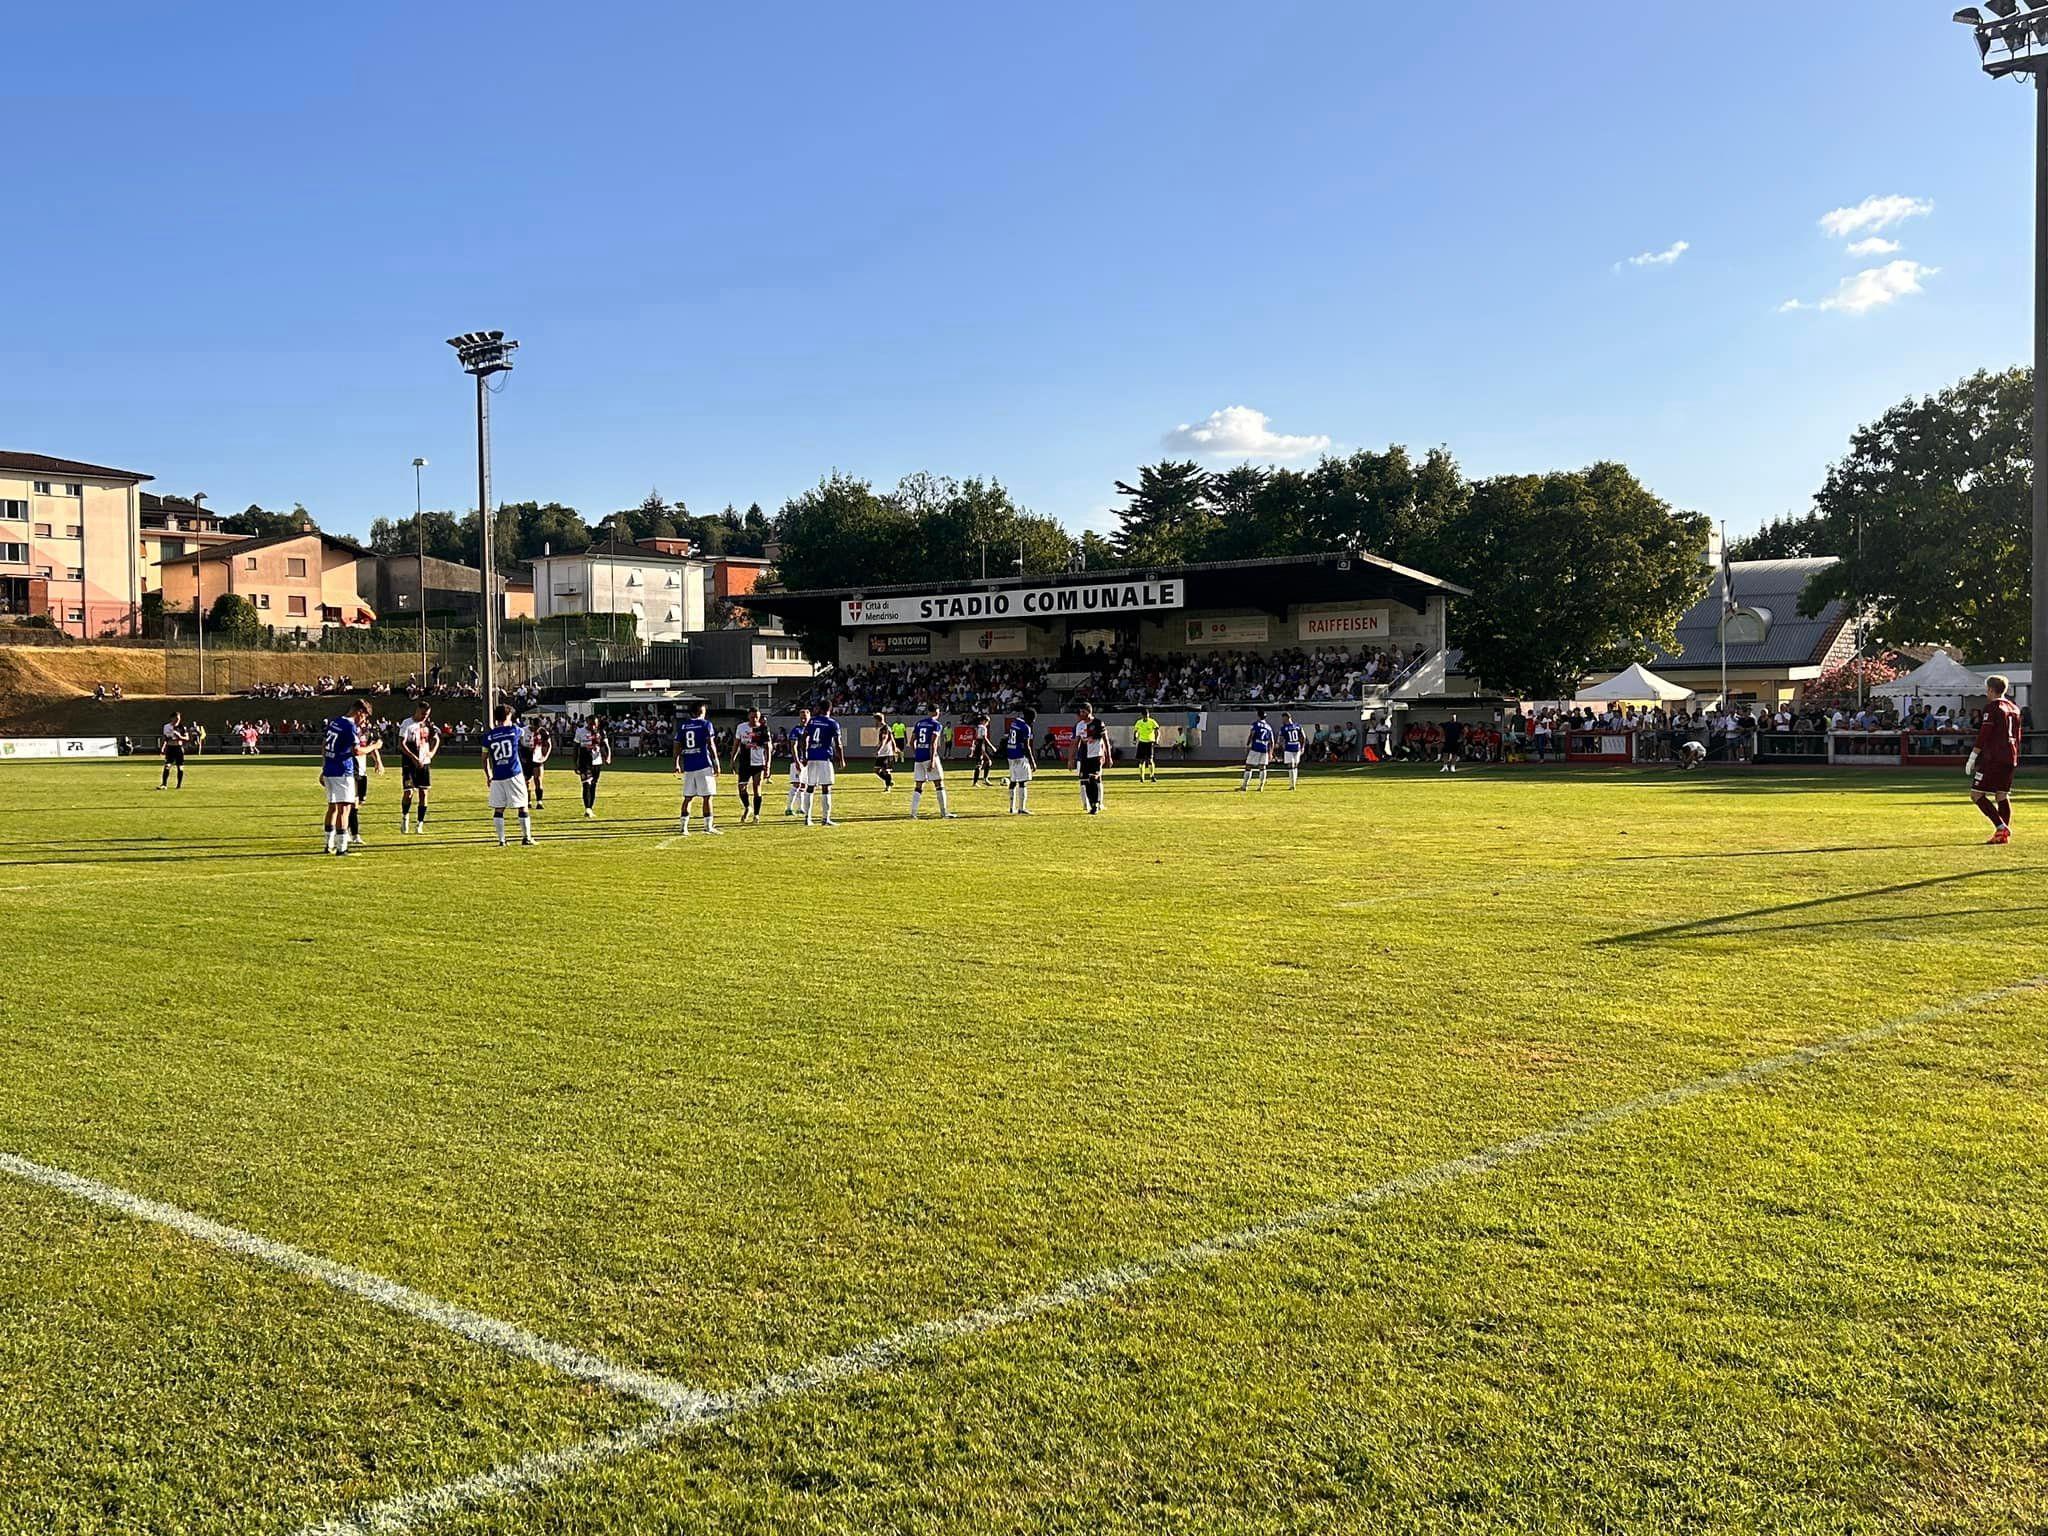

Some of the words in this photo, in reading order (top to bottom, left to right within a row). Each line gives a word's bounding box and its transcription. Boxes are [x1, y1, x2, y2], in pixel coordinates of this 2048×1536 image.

[865, 602, 881, 610] Città
[882, 600, 889, 609] di
[920, 595, 1009, 618] STADIO
[1023, 584, 1174, 612] COMUNALE
[865, 612, 899, 621] Mendrisio
[1309, 617, 1378, 633] RAIFFEISEN
[887, 636, 927, 646] FOXTOWN
[325, 730, 339, 752] 27
[686, 730, 695, 748] 8
[812, 728, 820, 743] 4
[919, 727, 927, 743] 5
[1260, 728, 1269, 740] 7
[1287, 730, 1299, 742] 10
[490, 739, 513, 760] 20
